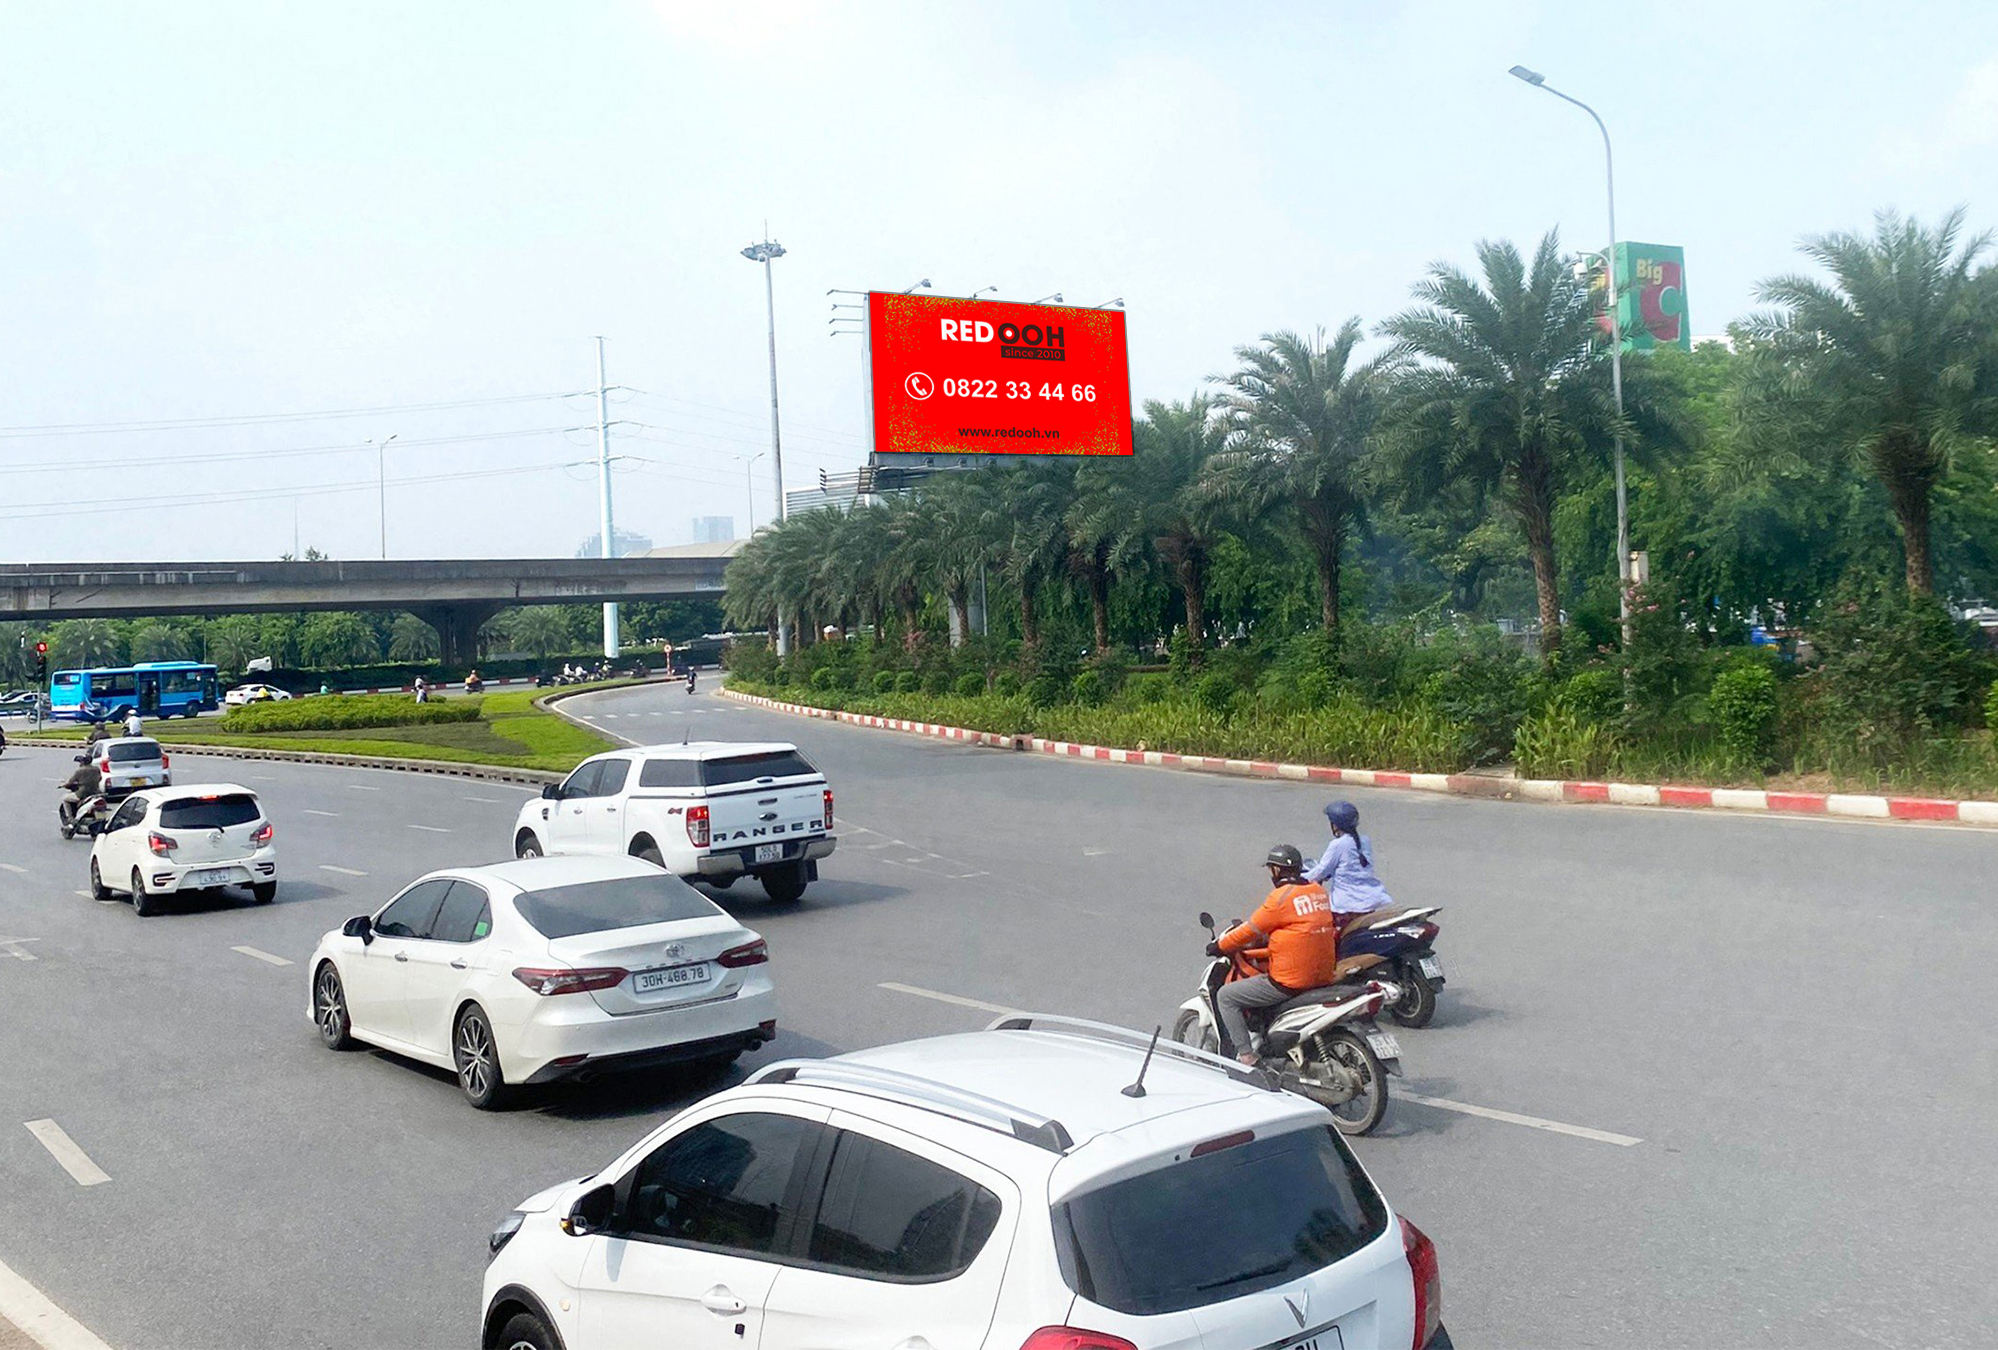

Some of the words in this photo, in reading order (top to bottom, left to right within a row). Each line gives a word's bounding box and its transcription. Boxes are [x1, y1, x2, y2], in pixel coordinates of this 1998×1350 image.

[1636, 258, 1663, 285] Big
[1640, 261, 1682, 341] C
[940, 318, 994, 343] RED
[998, 322, 1065, 348] OOH
[1004, 348, 1034, 359] since
[1036, 349, 1062, 360] 2010
[943, 378, 998, 399] 0822
[1005, 380, 1032, 400] 33
[1038, 382, 1065, 401] 44
[1071, 384, 1097, 402] 66
[958, 427, 1060, 439] www.redooh.vn
[713, 819, 823, 842] RANGER
